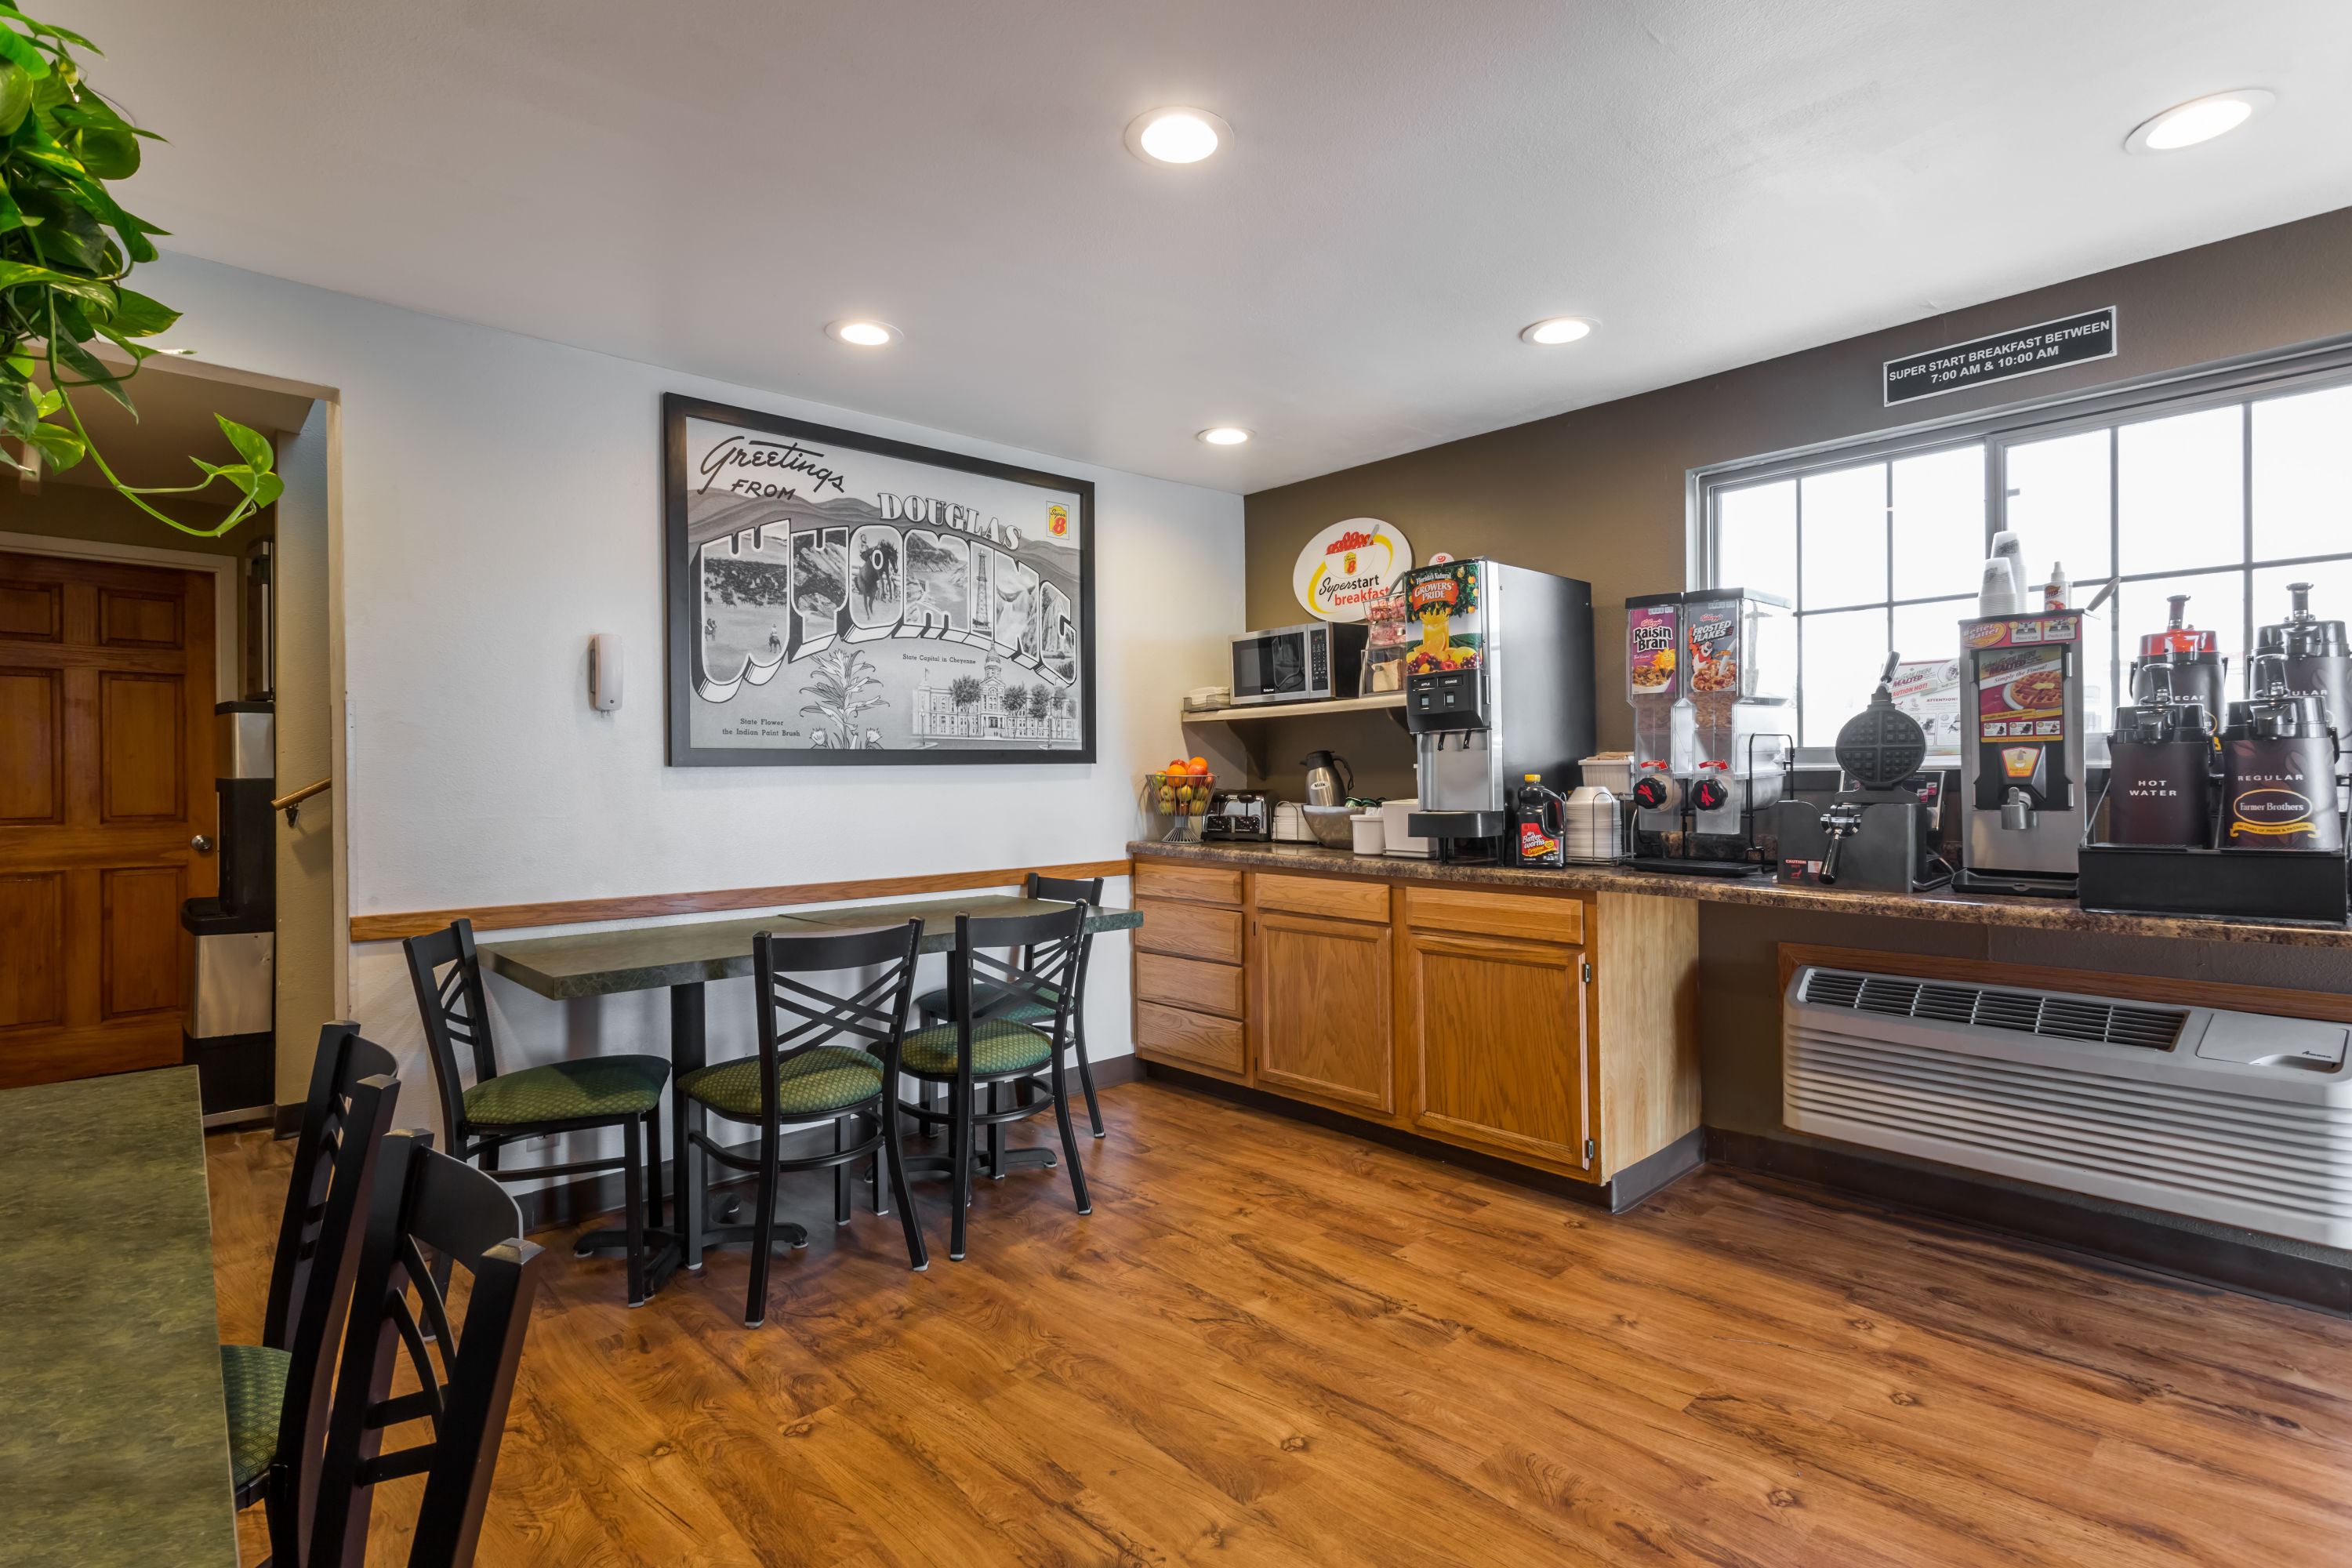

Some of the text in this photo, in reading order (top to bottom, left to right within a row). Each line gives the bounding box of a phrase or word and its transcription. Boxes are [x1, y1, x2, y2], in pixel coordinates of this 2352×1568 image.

[1889, 320, 2110, 382] SUPER START BREAKFAST BETWEEN
[1931, 345, 2060, 383] 7:00 AM & 10:00 AM
[697, 435, 844, 495] Greetings
[730, 478, 797, 501] FROM
[877, 492, 1022, 550] DOUGLAS
[1050, 508, 1066, 521] Super
[1053, 517, 1066, 535] 8
[1347, 560, 1356, 574] 8
[1319, 574, 1380, 602] Superstart
[1422, 590, 1446, 601] PRIDE
[1334, 586, 1390, 607] breakfast
[691, 518, 1077, 703] WYOMING
[1634, 627, 1673, 642] Raisin
[1693, 620, 1732, 637] FROSTED
[1964, 623, 1994, 636] Better
[1969, 627, 2000, 641] Batter
[1693, 629, 1726, 644] FLAKES
[1637, 637, 1669, 652] Bran
[1893, 674, 1923, 687] MALTED
[1994, 673, 2015, 683] Simply
[1892, 683, 1928, 697] AUTION HOT!
[2240, 802, 2304, 811] Farmer Brothers
